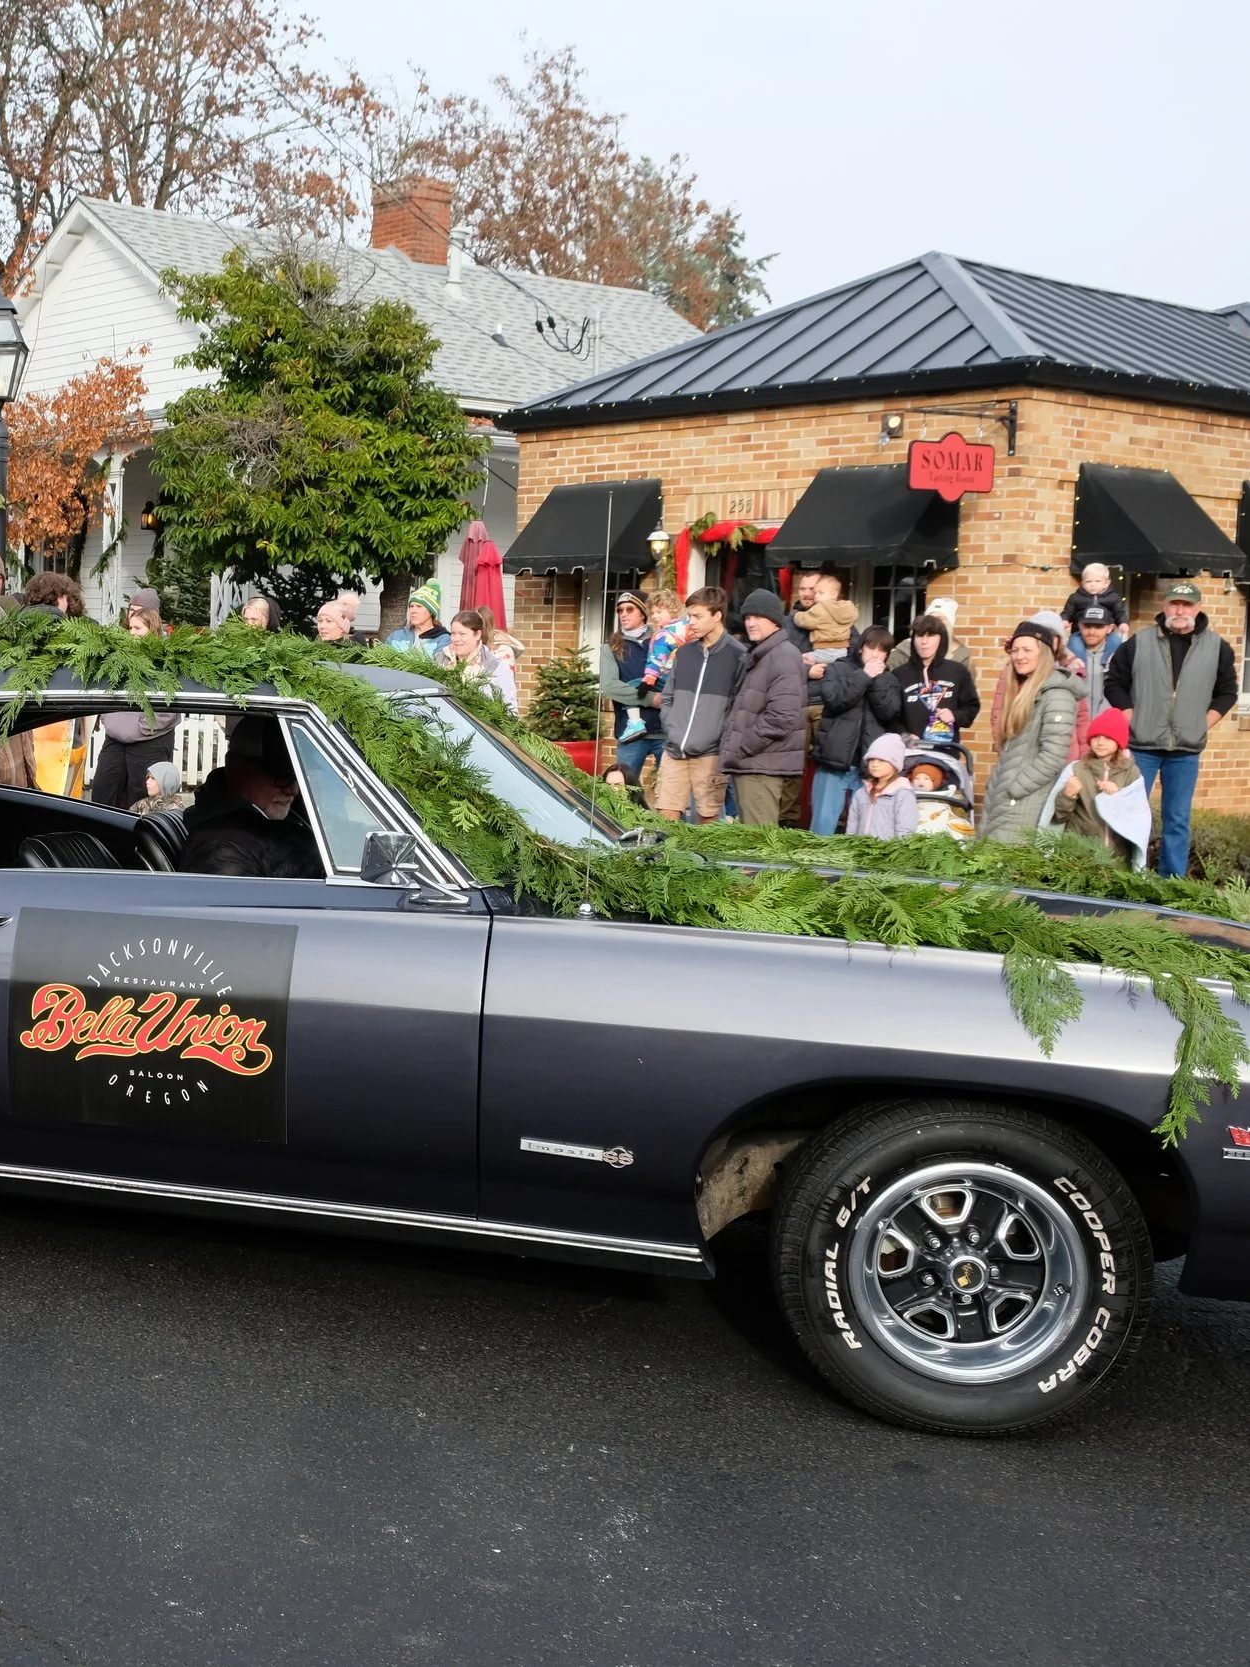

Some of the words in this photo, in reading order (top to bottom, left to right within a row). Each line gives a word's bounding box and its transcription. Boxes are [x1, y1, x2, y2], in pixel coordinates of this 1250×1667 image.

[922, 450, 983, 471] SOMAR
[87, 938, 233, 997] JACKSONVILLE
[114, 976, 206, 990] RESTAURANT
[20, 983, 142, 1060] Bella
[134, 992, 273, 1076] Union
[109, 1074, 209, 1105] OREGON
[129, 1069, 184, 1081] SALOON
[527, 1142, 596, 1158] Impala
[835, 1176, 872, 1228] G/T
[1054, 1177, 1117, 1296] COOPER
[824, 1240, 862, 1350] RADIAL
[1038, 1306, 1111, 1394] COBRA
